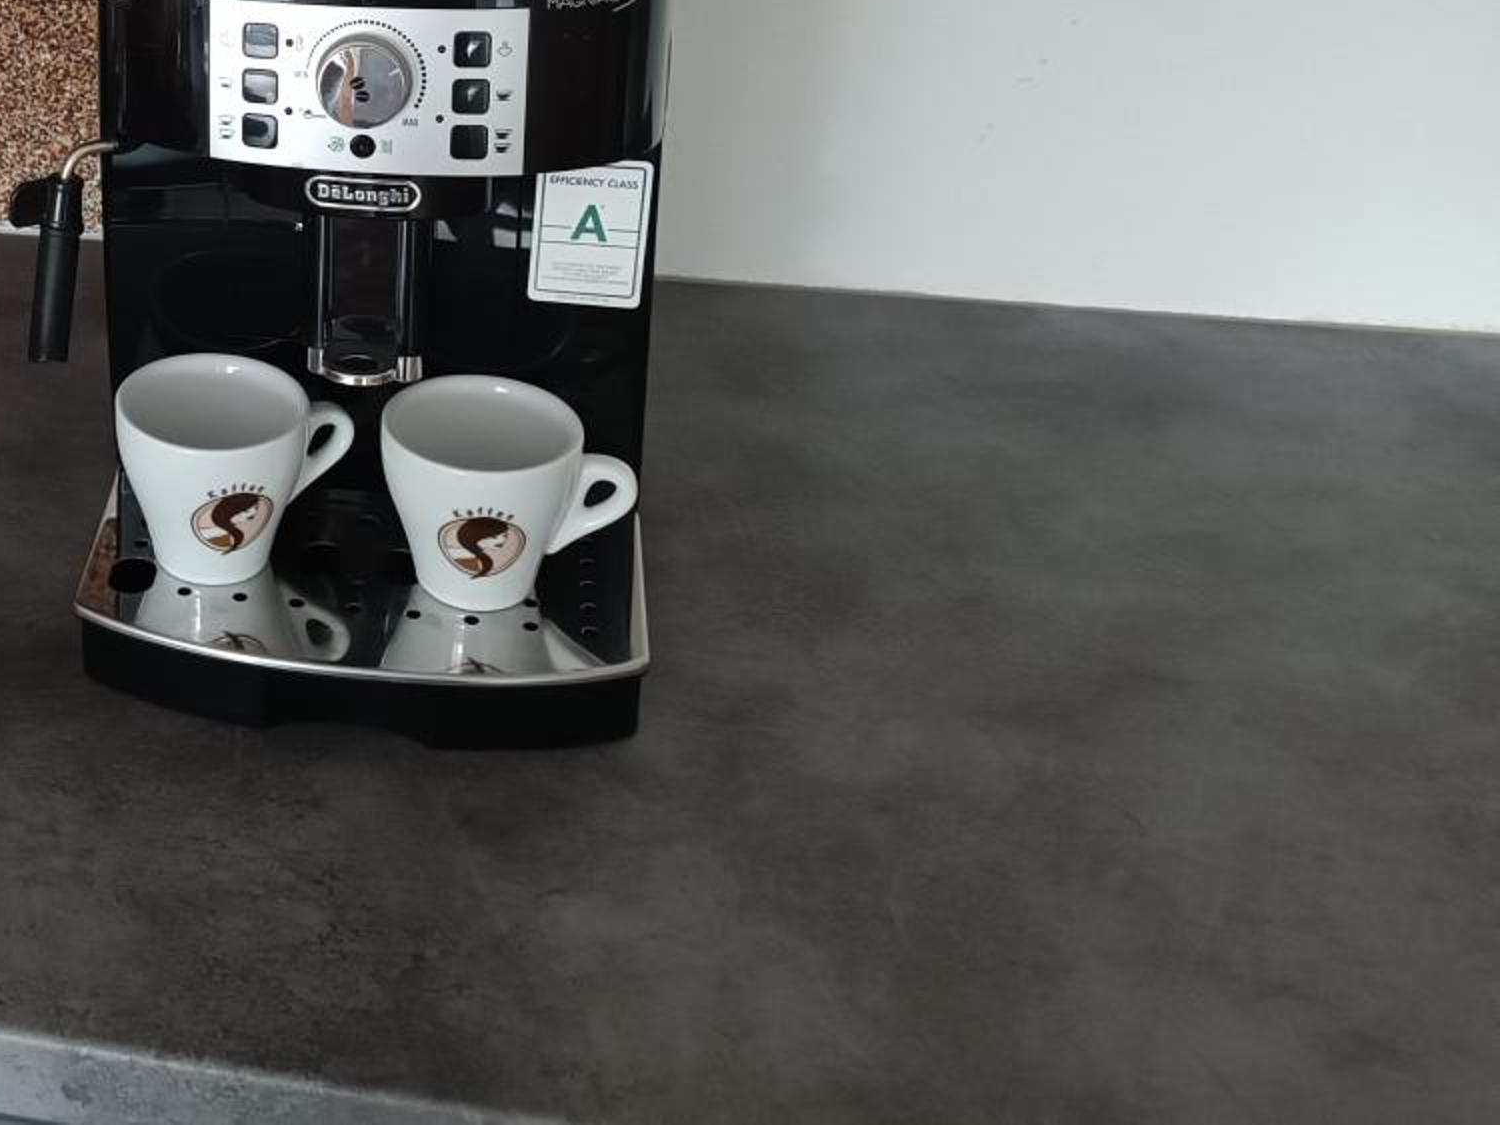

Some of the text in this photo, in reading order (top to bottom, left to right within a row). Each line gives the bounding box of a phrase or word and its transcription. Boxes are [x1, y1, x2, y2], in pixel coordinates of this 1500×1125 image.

[549, 174, 639, 191] EFFICIENCY CLASS
[570, 204, 607, 243] A
